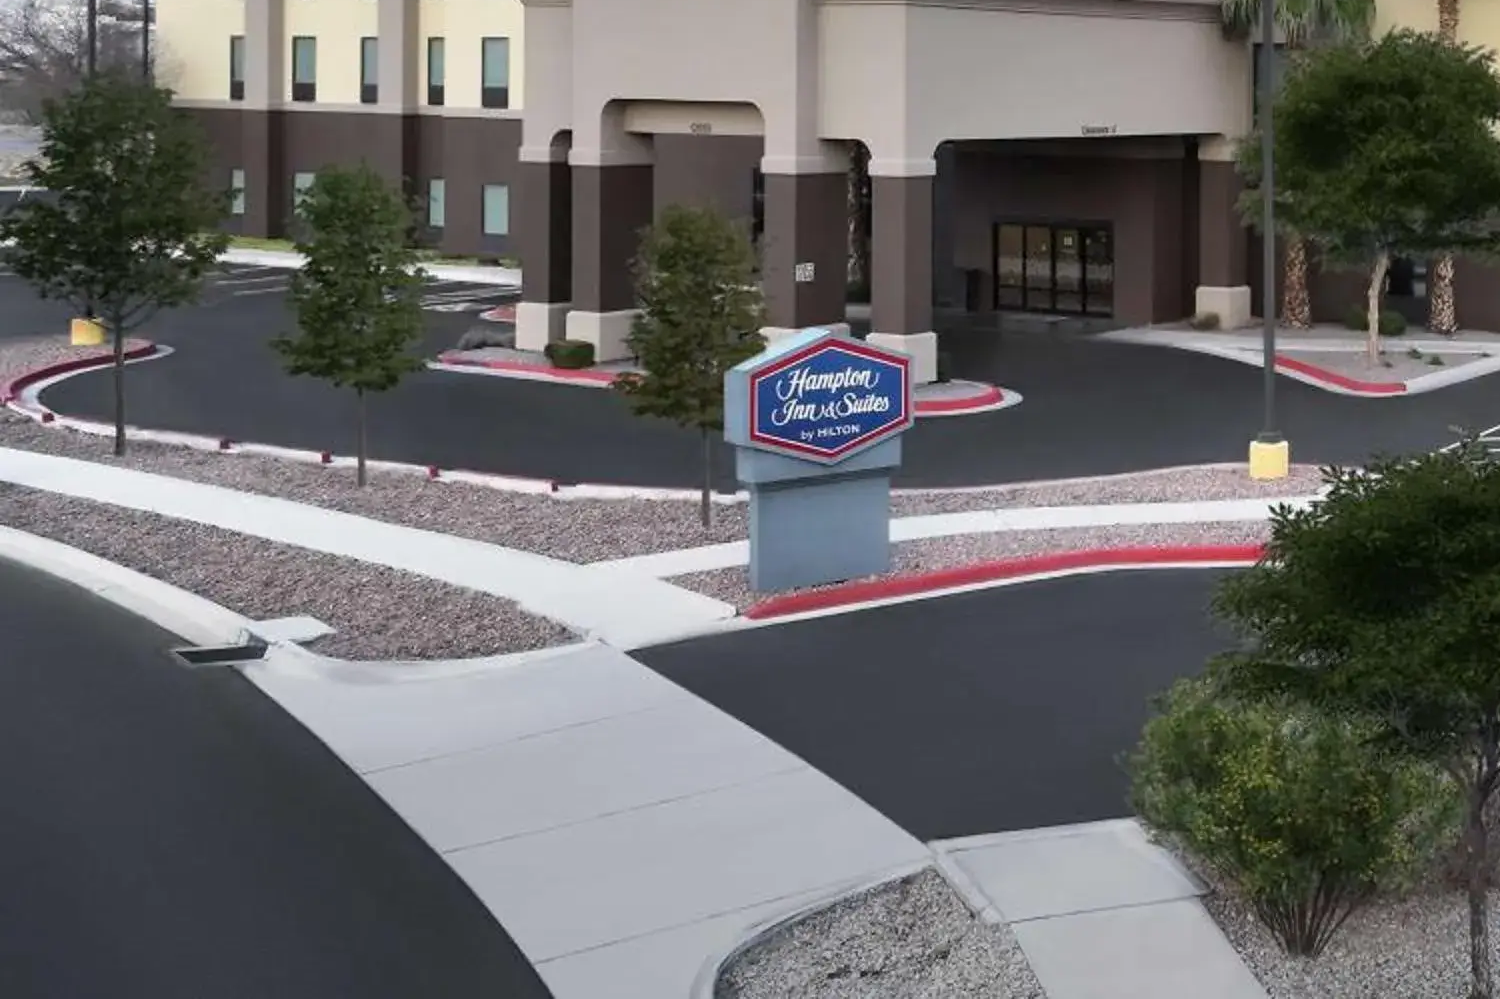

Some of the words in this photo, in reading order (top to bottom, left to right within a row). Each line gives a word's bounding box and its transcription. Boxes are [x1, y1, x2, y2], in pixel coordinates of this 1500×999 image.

[777, 367, 880, 401] Hampton
[771, 397, 824, 426] Inn
[837, 393, 889, 416] Suites
[800, 431, 815, 442] by
[817, 425, 860, 438] HILTON
